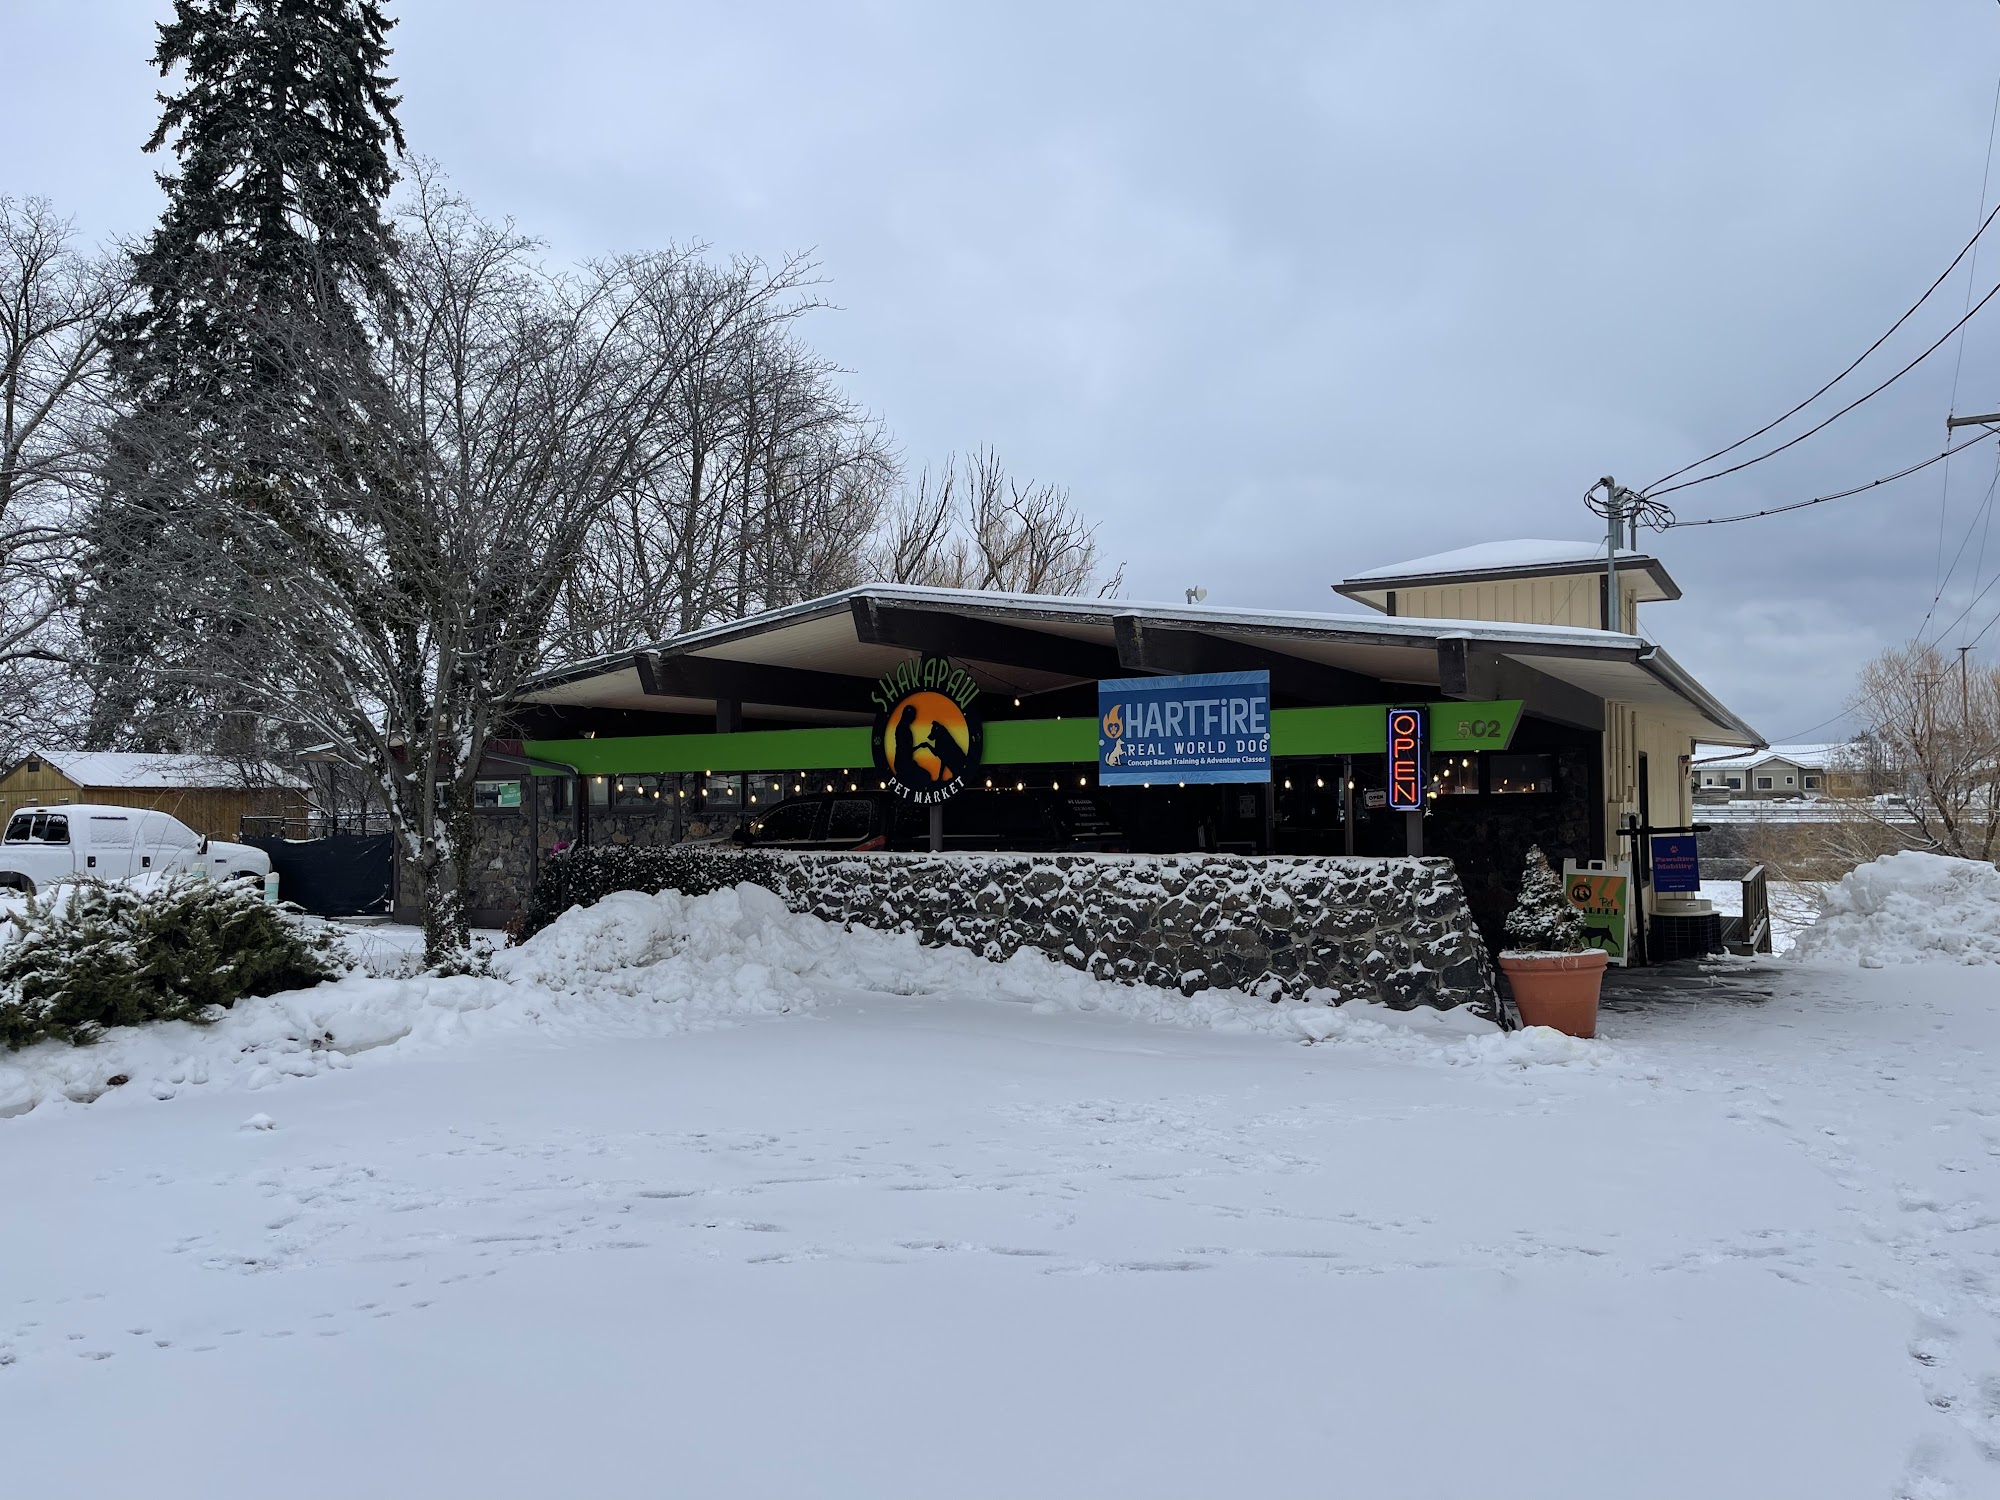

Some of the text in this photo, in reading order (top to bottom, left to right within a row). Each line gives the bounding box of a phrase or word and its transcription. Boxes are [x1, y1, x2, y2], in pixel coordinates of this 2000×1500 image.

[871, 655, 980, 713] SHAKAPAW
[1456, 720, 1501, 739] 502
[1127, 739, 1268, 756] REAL WORLD DOG
[1127, 755, 1266, 767] Concept Based Training & Adventure Classes
[1393, 715, 1416, 803] OPEN
[887, 775, 965, 804] PET MARKET
[1581, 907, 1620, 915] ARKET
[1598, 897, 1614, 907] Pet
